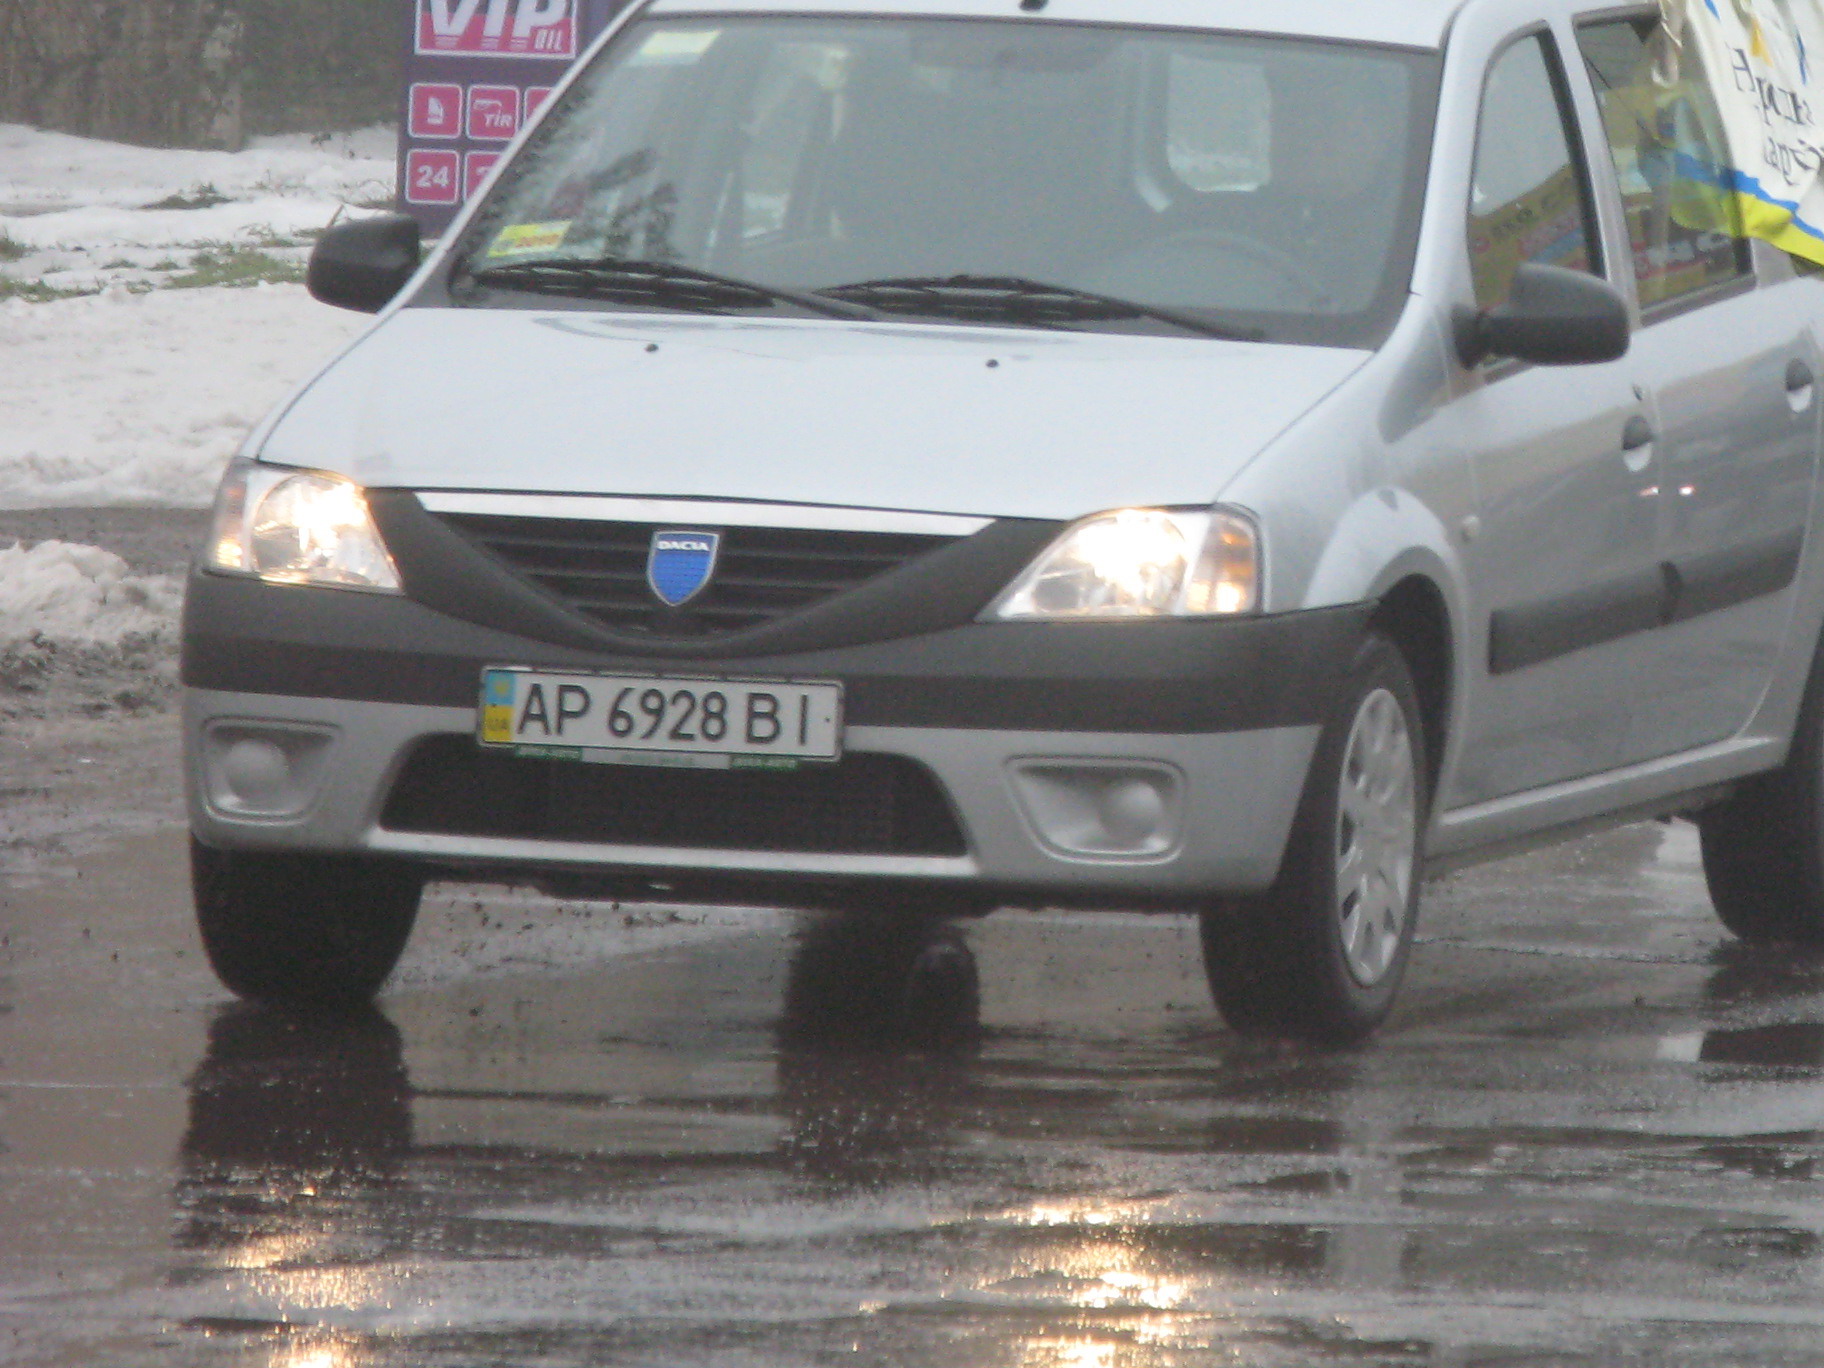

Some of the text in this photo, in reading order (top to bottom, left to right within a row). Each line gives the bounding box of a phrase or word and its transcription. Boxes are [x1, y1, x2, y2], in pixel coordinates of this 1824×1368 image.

[485, 114, 512, 127] TIR
[416, 165, 449, 188] 24
[607, 687, 728, 742] 6928
